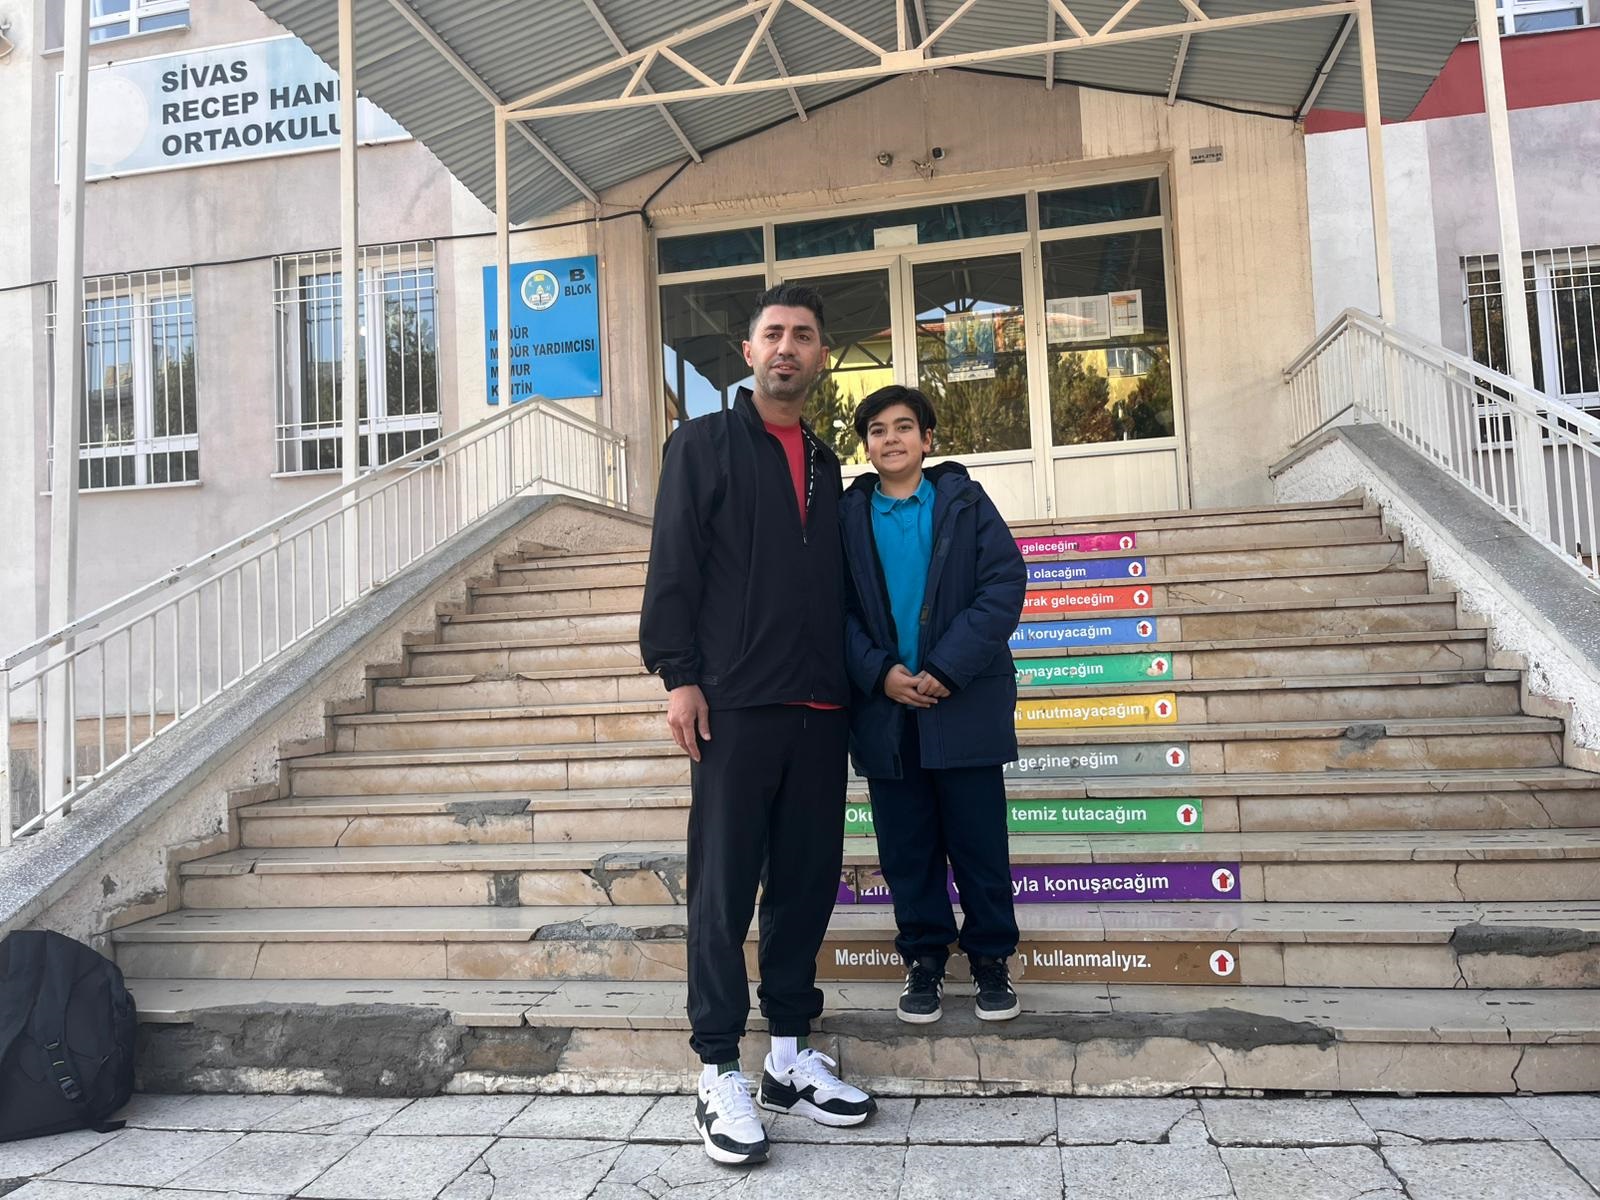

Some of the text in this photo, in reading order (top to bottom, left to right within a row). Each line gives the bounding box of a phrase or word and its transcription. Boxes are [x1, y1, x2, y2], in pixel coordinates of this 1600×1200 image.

[161, 60, 248, 93] SİVAS
[162, 91, 259, 125] RECEP
[162, 113, 341, 156] ORTAOKULU
[569, 268, 586, 282] B
[564, 284, 592, 296] BLOK
[532, 338, 595, 356] YARDIMCISI
[1021, 541, 1078, 555] geleceğim
[1033, 566, 1087, 579] olacağım
[1051, 593, 1114, 608] geleceğim
[1027, 625, 1112, 641] koruyacağım
[1026, 703, 1145, 721] unutmayacağım
[1018, 752, 1119, 772] geçineceğim
[1011, 807, 1057, 821] temiz
[1061, 806, 1147, 824] tutacağım
[1044, 873, 1169, 894] konuşacağım
[1033, 949, 1152, 972] kullanmalıyız.
